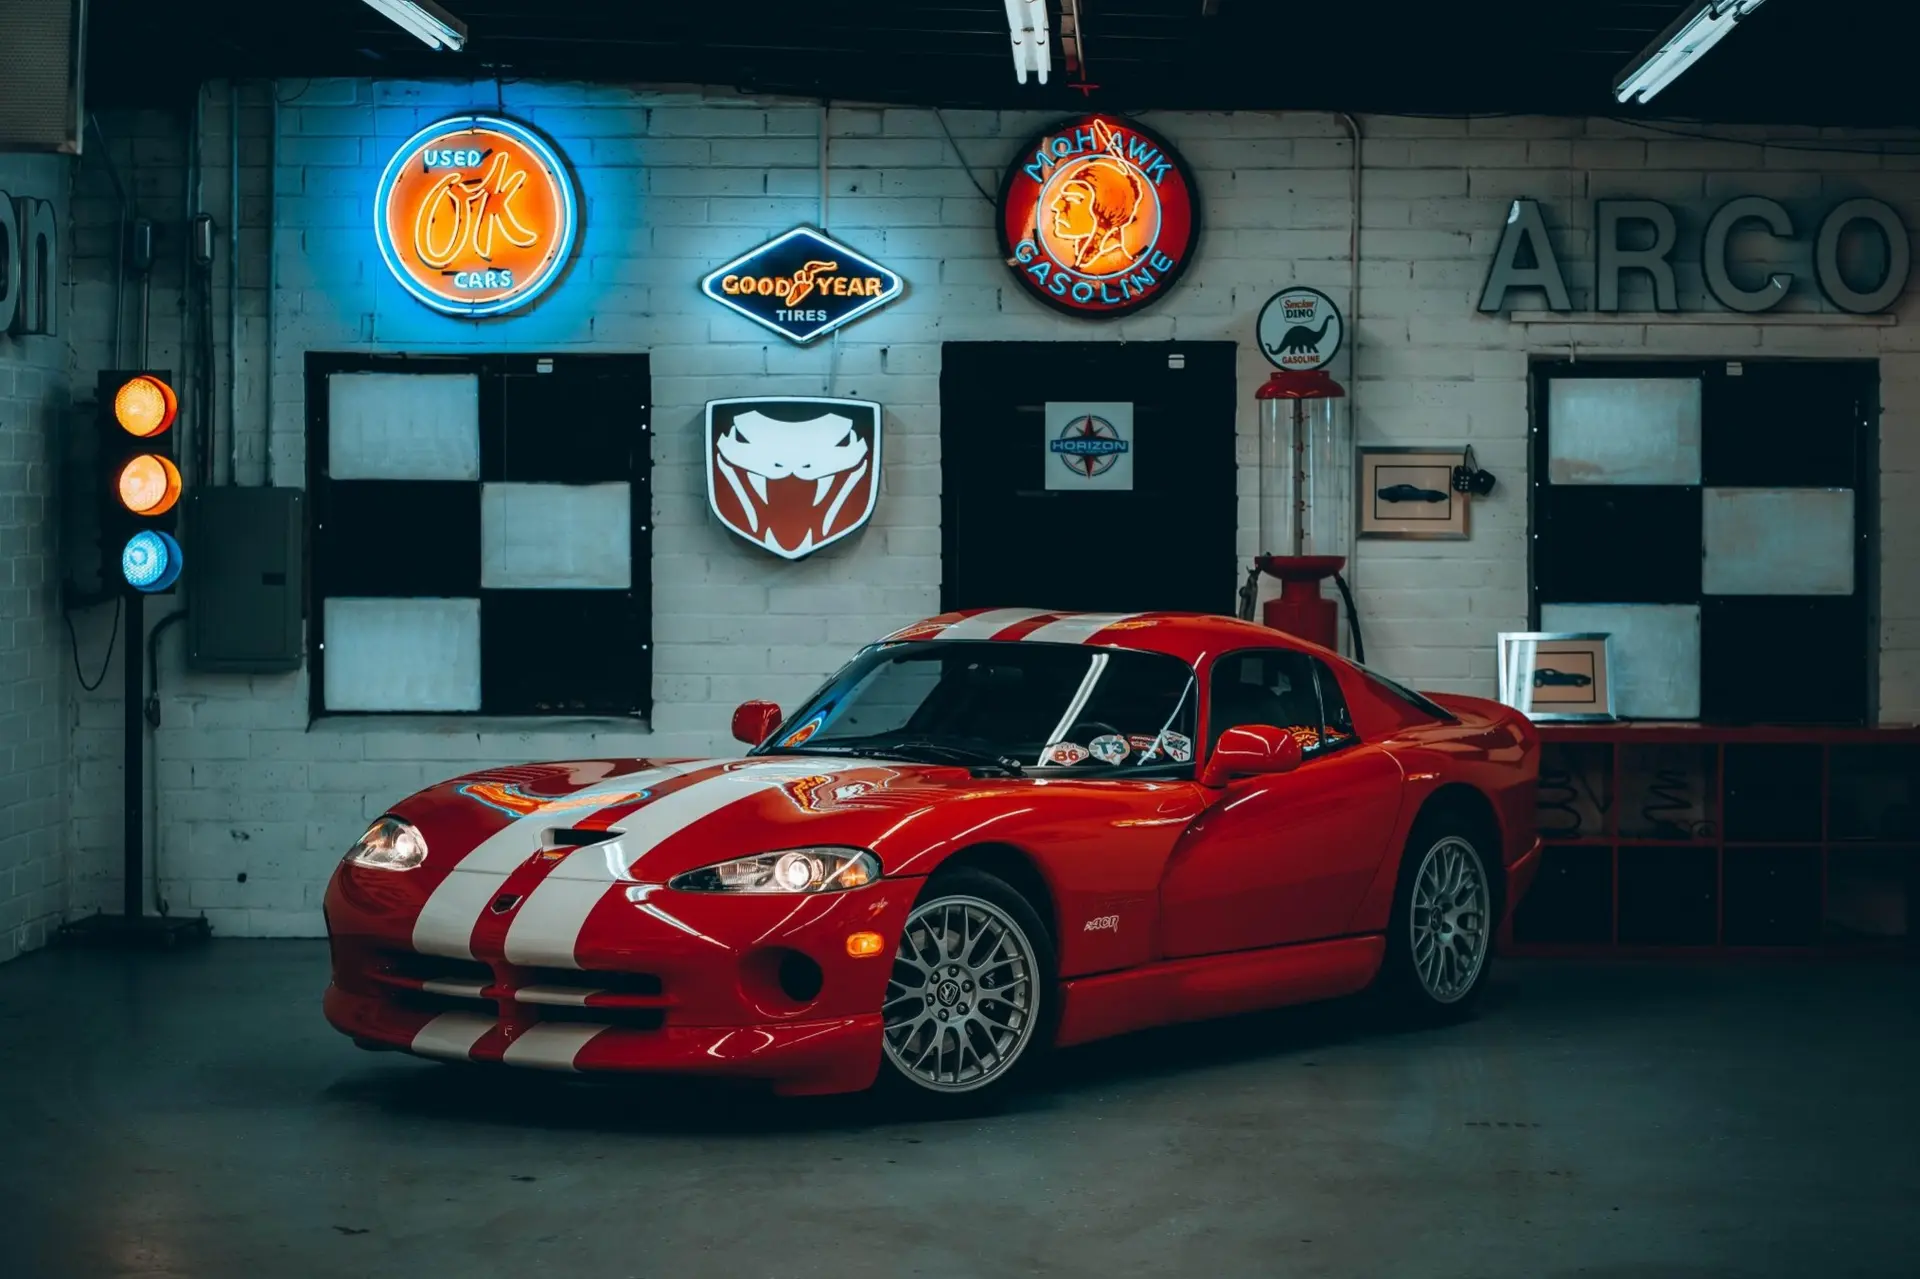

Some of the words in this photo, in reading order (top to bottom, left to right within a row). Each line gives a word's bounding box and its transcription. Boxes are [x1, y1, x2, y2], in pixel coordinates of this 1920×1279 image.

[423, 149, 481, 167] USED
[1023, 127, 1173, 186] MOHAWK
[414, 151, 538, 268] OK
[1478, 196, 1910, 313] ARCO
[454, 270, 512, 289] CARS
[1015, 238, 1173, 303] GASOLINE
[776, 310, 827, 321] TIRES
[1286, 309, 1314, 318] DINO
[1282, 355, 1321, 364] GASOLINE
[1052, 441, 1127, 450] HORIZON
[1172, 749, 1184, 760] A1
